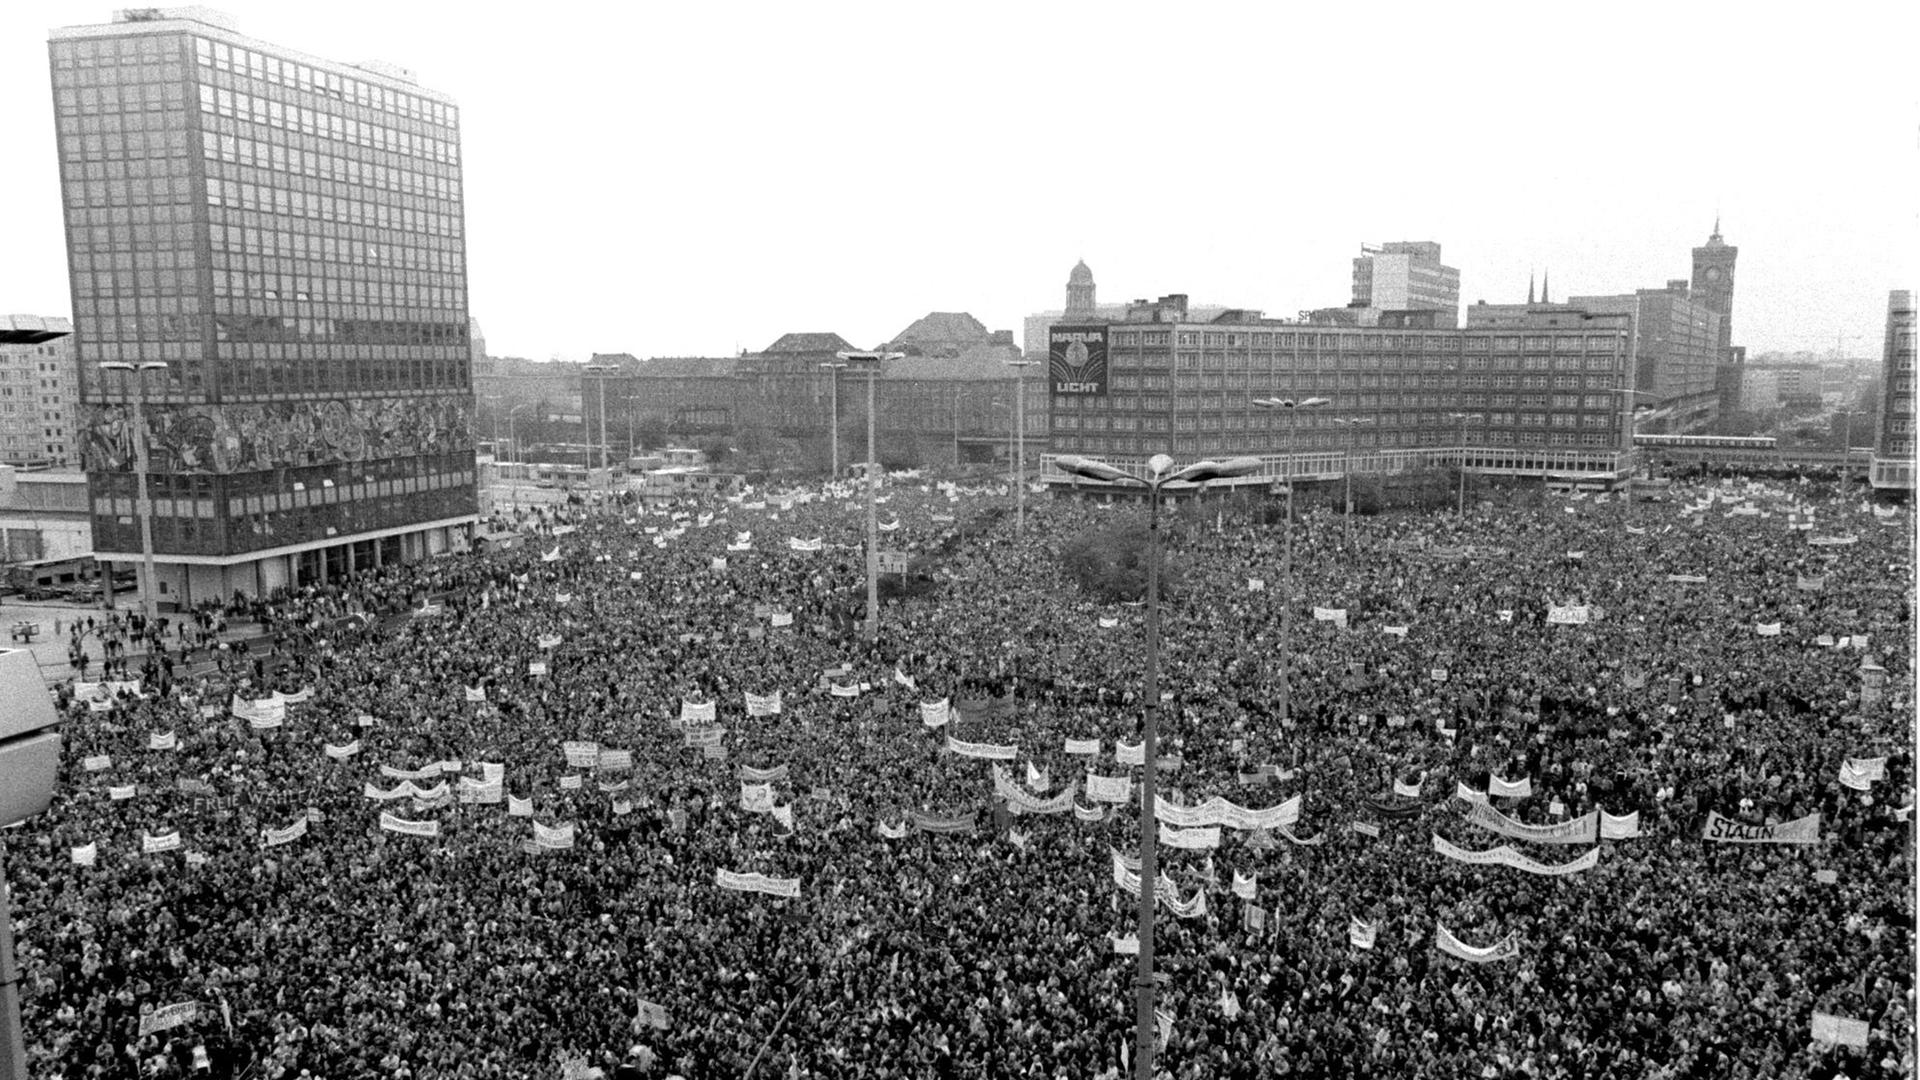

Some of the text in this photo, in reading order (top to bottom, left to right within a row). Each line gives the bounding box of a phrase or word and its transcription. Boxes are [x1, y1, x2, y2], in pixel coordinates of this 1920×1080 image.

[1051, 332, 1103, 343] NARVA
[1056, 382, 1099, 393] LICHT
[194, 794, 240, 811] FREIE
[1710, 817, 1774, 839] STALIN
